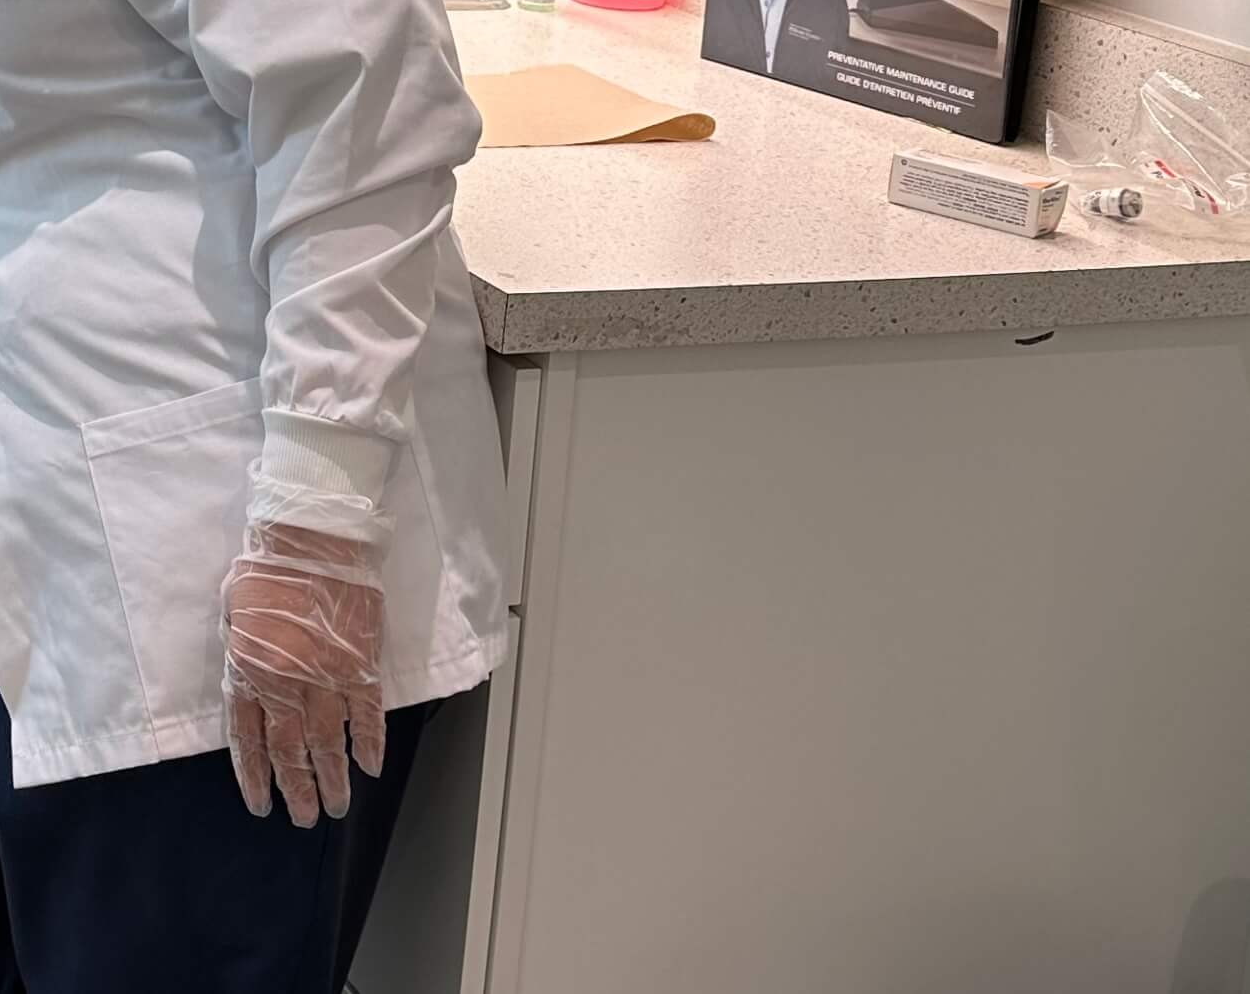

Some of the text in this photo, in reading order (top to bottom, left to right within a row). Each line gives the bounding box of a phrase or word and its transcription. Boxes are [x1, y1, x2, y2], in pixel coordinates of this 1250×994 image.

[828, 50, 975, 100] PREVENTATIVE MAINTENANCE GUIDE
[837, 72, 962, 115] GUIDE D'ENTRETIEN PRÉVENTIF
